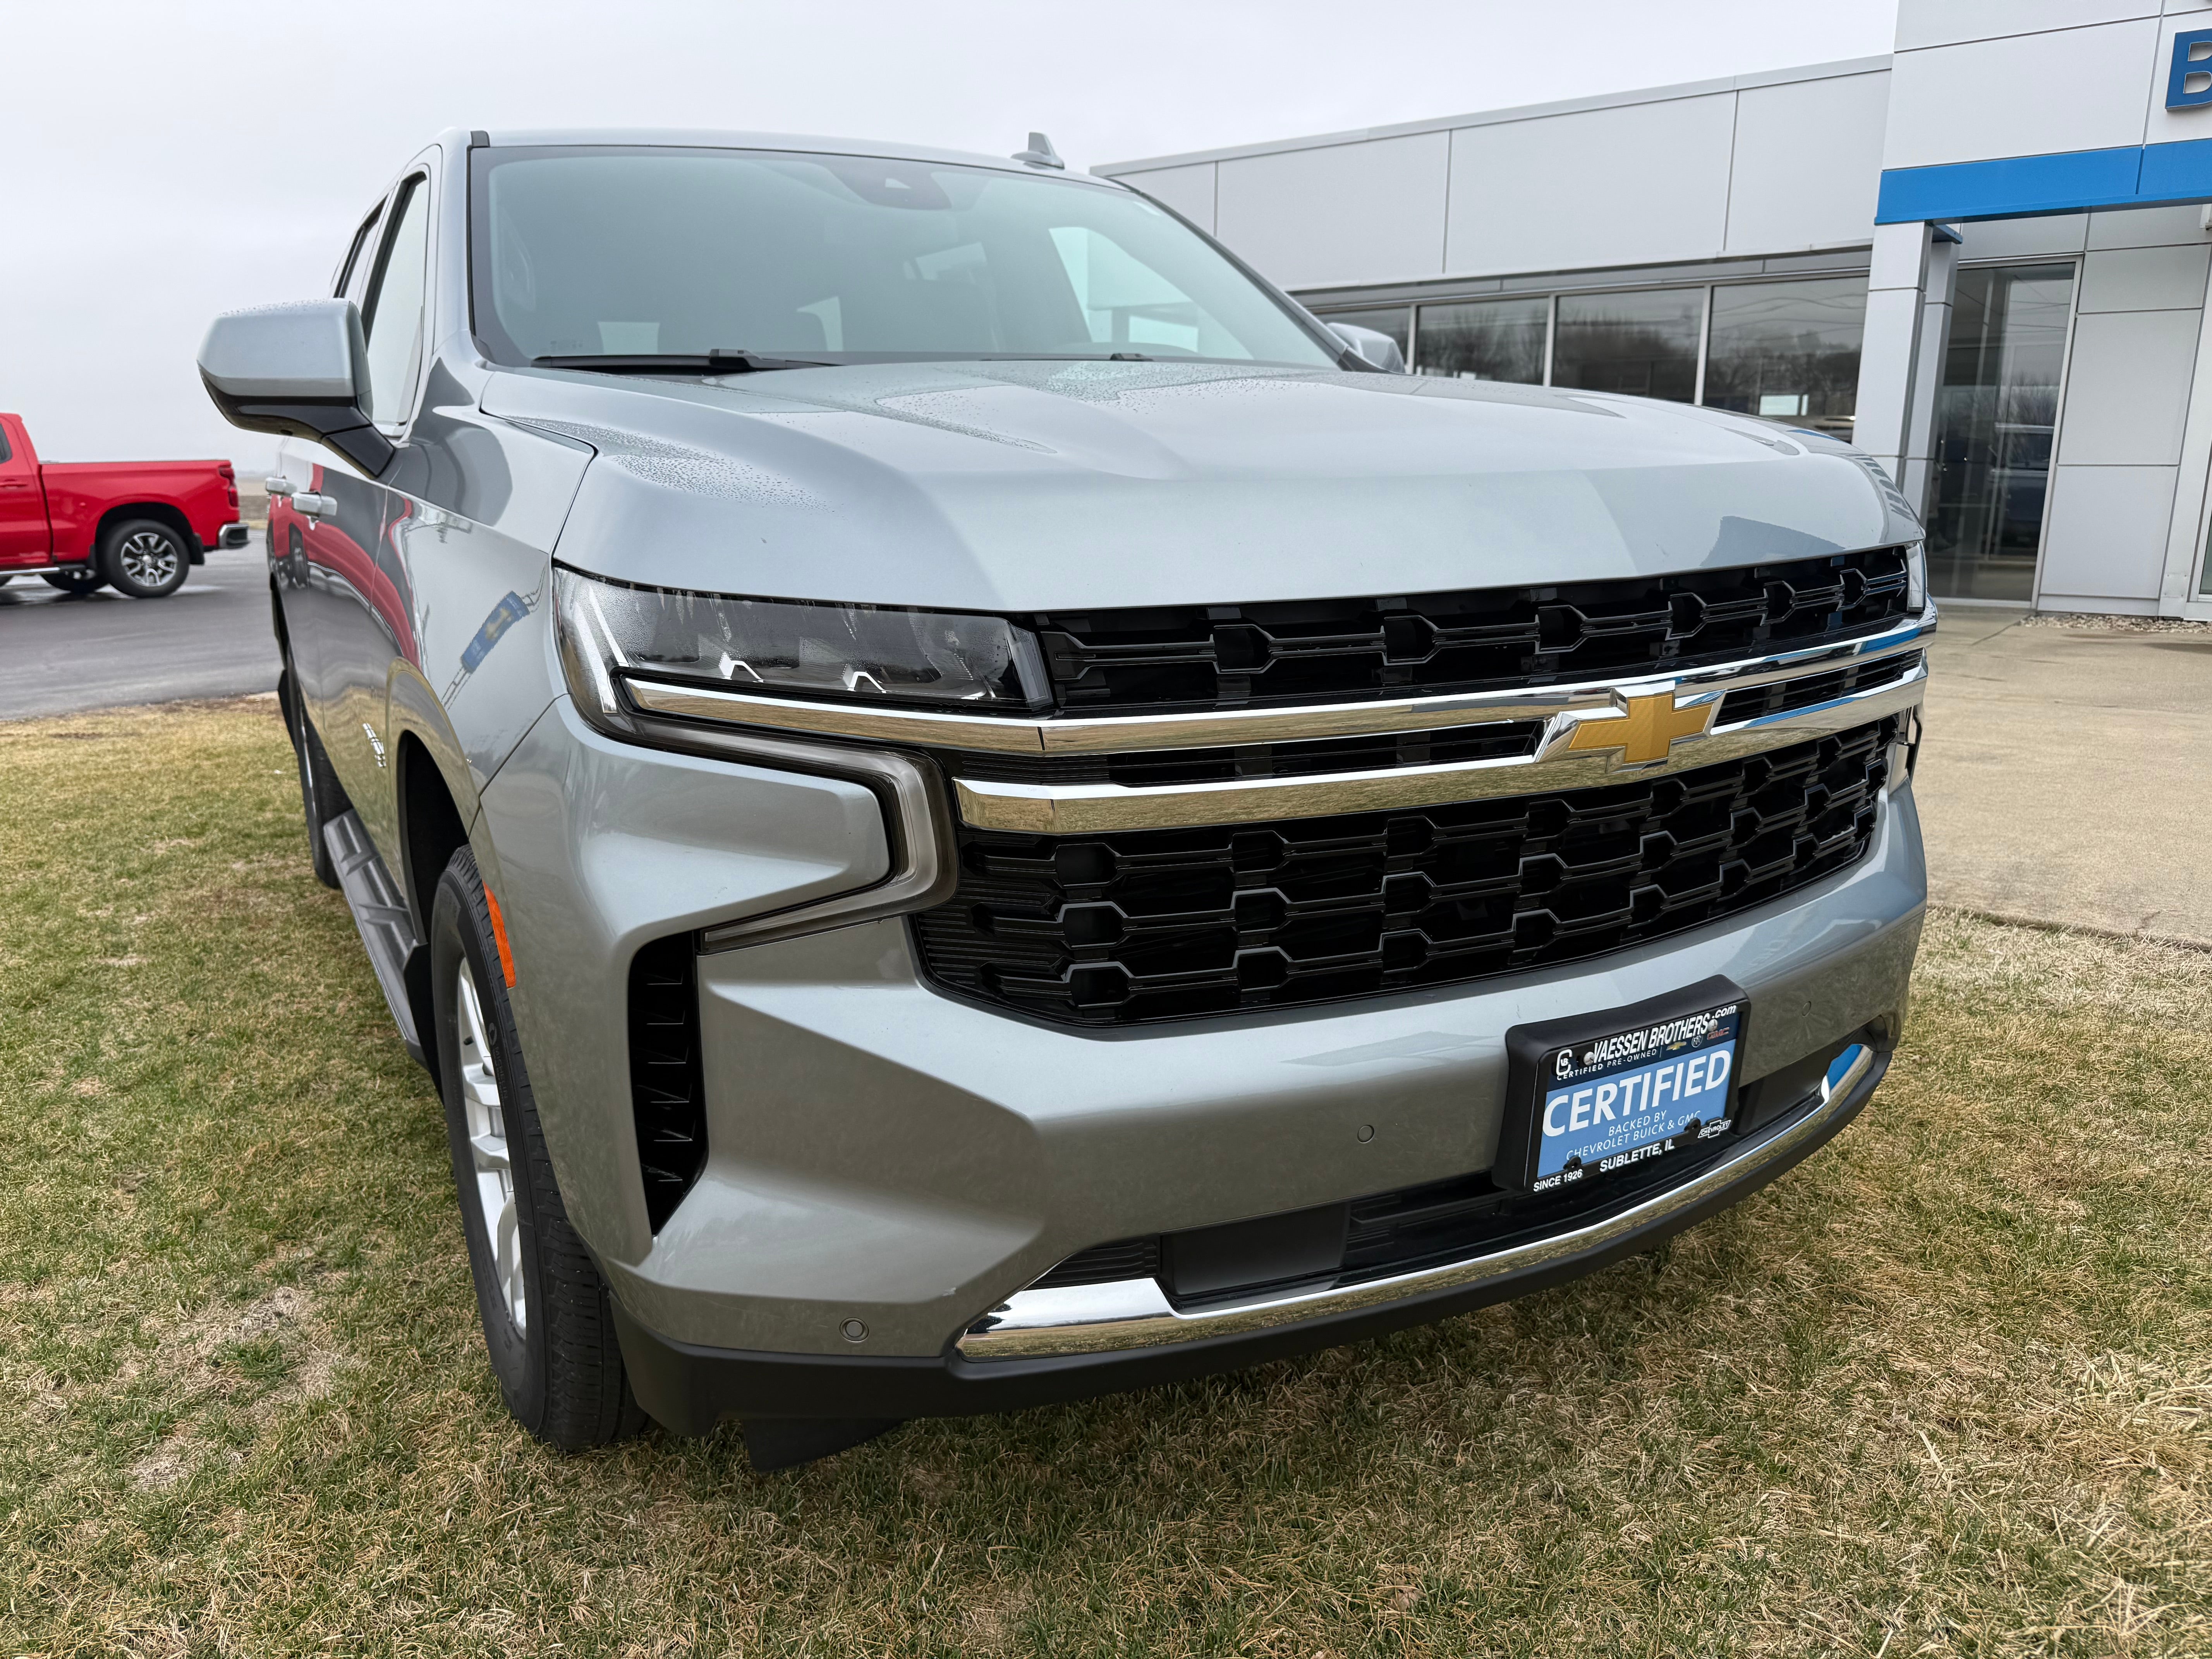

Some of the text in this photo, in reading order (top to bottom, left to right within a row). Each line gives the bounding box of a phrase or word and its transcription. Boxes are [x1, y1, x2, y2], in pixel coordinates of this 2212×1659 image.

[1594, 1030, 1649, 1063] VAESSEN
[1707, 1027, 1729, 1040] GMC
[494, 1046, 508, 1099] MICHELIN
[1557, 1049, 1657, 1080] CERTIFIED PRE-OWNED
[1542, 1050, 1731, 1137] CERTIFIED
[1609, 1110, 1667, 1136] BACKED BY
[1700, 1122, 1728, 1136] CHEVROLET
[1566, 1133, 1630, 1161] CHEVROLET
[1633, 1123, 1665, 1141] BUICK
[1667, 1120, 1674, 1130] &
[1599, 1139, 1675, 1173] SUBLETTE, IL
[1533, 1168, 1583, 1192] SINCE 1926
